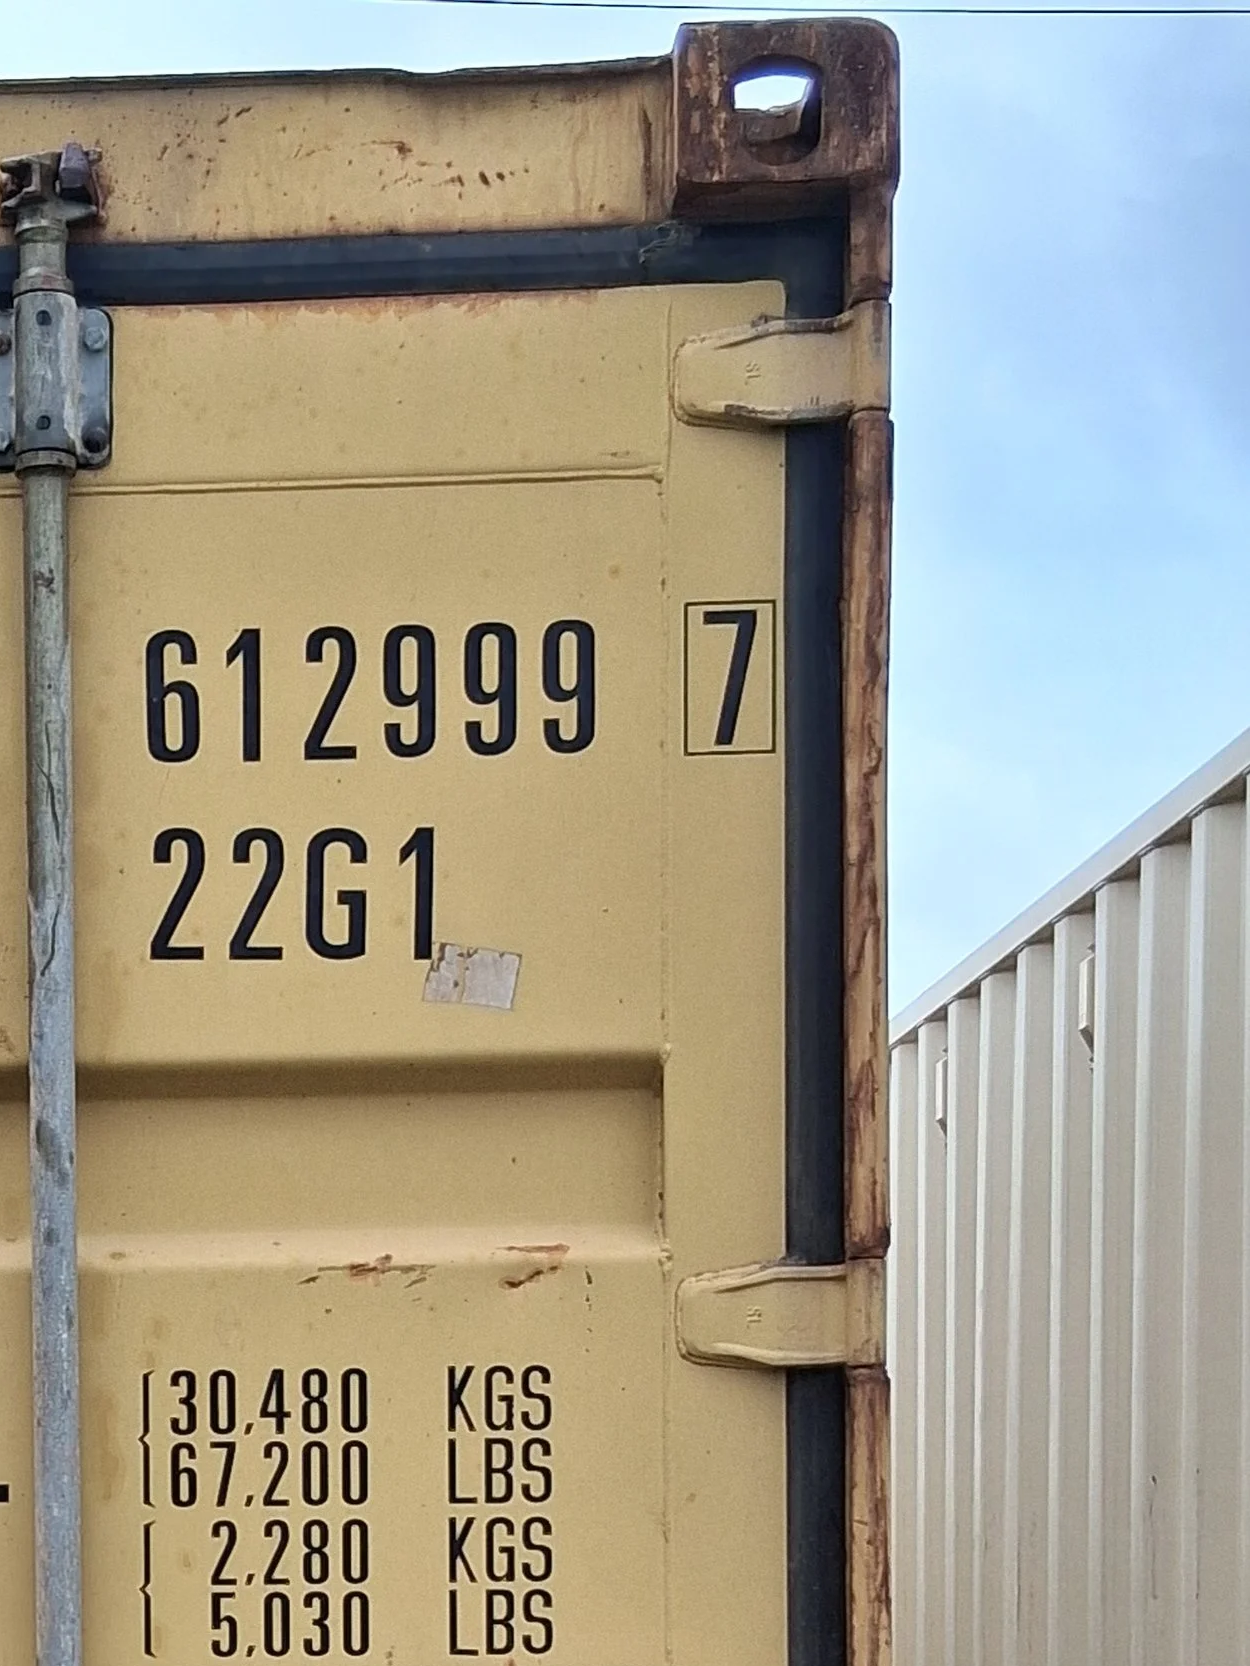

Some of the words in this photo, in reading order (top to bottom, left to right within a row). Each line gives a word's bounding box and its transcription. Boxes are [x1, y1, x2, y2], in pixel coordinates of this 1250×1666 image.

[145, 619, 596, 763] 612999
[703, 609, 758, 746] 7
[149, 826, 435, 961] 22G1
[170, 1367, 368, 1436] 30,480
[447, 1364, 552, 1432] KGS
[170, 1440, 368, 1508] 67,200
[448, 1437, 552, 1504] LBS
[211, 1518, 369, 1586] 2,280
[448, 1516, 553, 1583] KGS
[211, 1591, 370, 1658] 5,030
[449, 1588, 553, 1656] LBS
